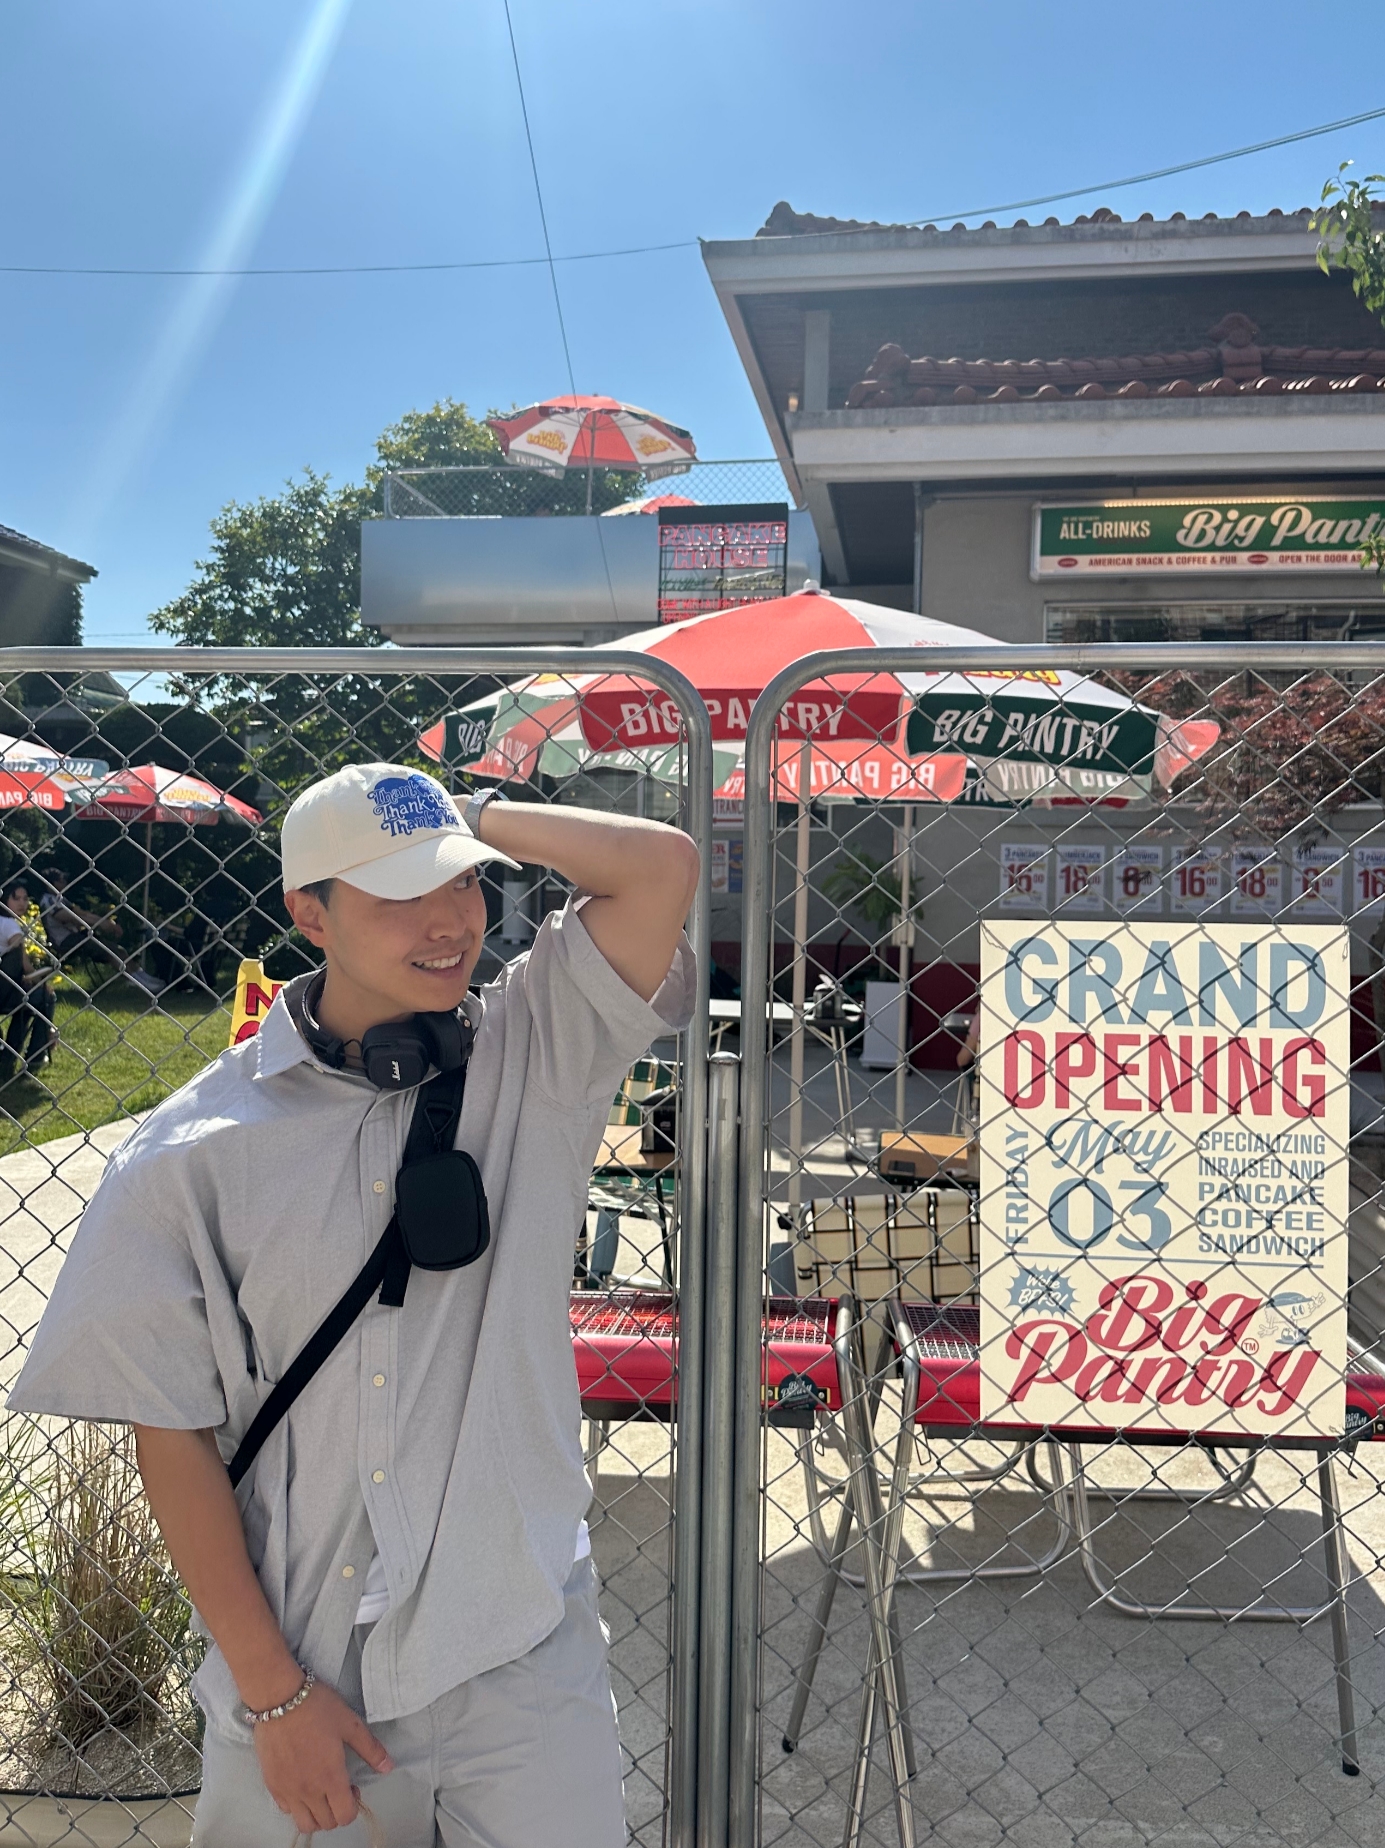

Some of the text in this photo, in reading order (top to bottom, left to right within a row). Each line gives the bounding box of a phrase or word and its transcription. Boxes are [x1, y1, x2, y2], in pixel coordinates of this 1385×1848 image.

[658, 522, 787, 546] PANCAKE
[1059, 520, 1151, 539] ALL-DRINKS
[1176, 508, 1266, 548] Big
[674, 546, 769, 570] HOUSE
[1088, 557, 1133, 567] AMERICAN
[1135, 556, 1163, 566] SNACK
[1166, 556, 1173, 565] &
[1175, 555, 1207, 565] COFFEE
[1210, 555, 1217, 565] &
[1278, 554, 1302, 564] OPEN
[1305, 554, 1321, 563] THE
[1324, 554, 1348, 563] DOOR
[620, 697, 845, 737] BIG PATRY
[932, 709, 1120, 760] BIG PANTRY
[373, 795, 434, 821] Thank
[380, 808, 460, 836] Thank You
[1007, 863, 1032, 894] 16
[1061, 864, 1089, 896] 18
[1176, 866, 1206, 897] 16
[1236, 867, 1266, 898] 18
[1004, 937, 1327, 1029] GRAND
[1004, 1029, 1326, 1118] OPENING
[1045, 1117, 1177, 1175] May
[1198, 1130, 1326, 1155] SPECIALIZING
[1005, 1123, 1029, 1245] FRIDAY
[1198, 1156, 1325, 1181] INRAISED AND
[1198, 1181, 1325, 1206] PANCAKE
[1047, 1177, 1172, 1251] 03
[1198, 1207, 1325, 1232] COFFEE
[1198, 1233, 1325, 1258] SANDWICH
[1084, 1274, 1264, 1357] Big
[1243, 1341, 1257, 1352] TM
[1005, 1318, 1324, 1417] Pantry
